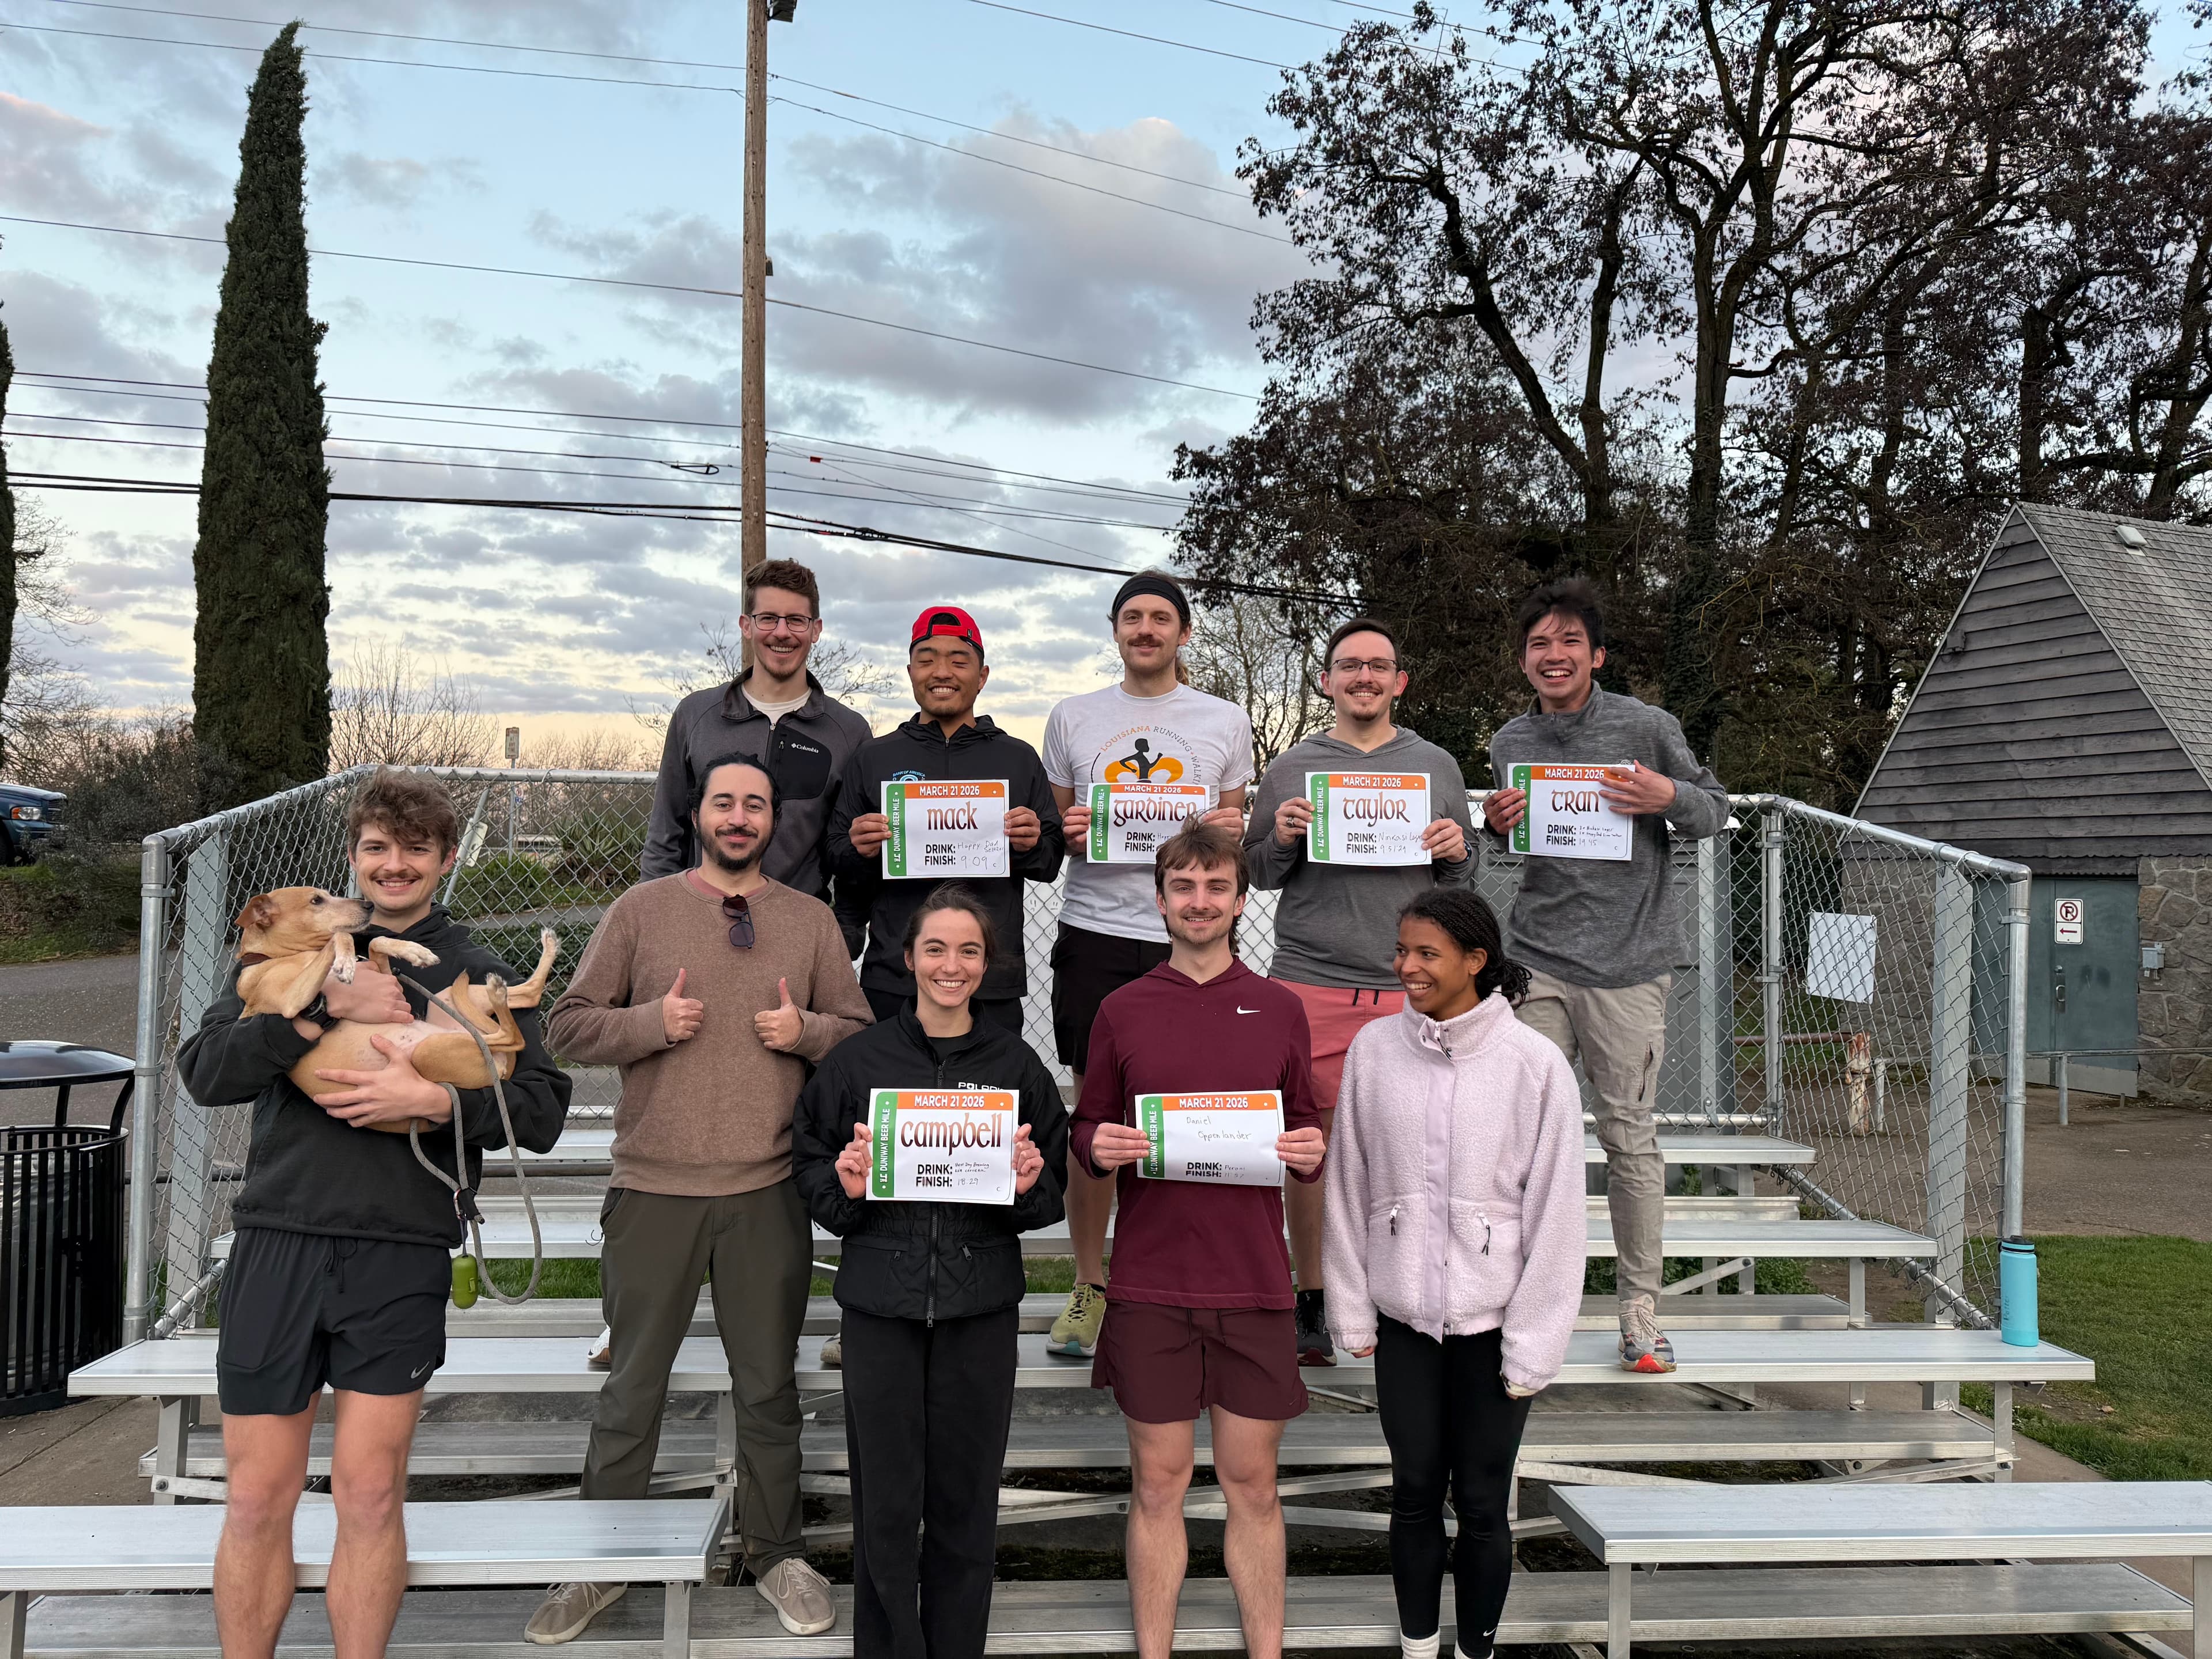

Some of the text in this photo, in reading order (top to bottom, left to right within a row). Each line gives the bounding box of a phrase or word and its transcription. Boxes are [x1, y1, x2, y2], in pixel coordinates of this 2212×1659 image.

[796, 744, 819, 753] Columbia
[1101, 726, 1151, 752] LOUISIANA
[1153, 726, 1192, 752] RUNNING
[1191, 756, 1202, 785] WALKI
[1545, 768, 1604, 779] MARCH 21 2026
[1343, 777, 1402, 787] MARCH 21 2026
[920, 785, 980, 796] MARCH 21 2026
[927, 801, 979, 830] mack
[1547, 824, 1577, 835] DRINK:
[893, 827, 901, 851] DUNIWAY
[1126, 832, 1156, 842] DRINK:
[1347, 833, 1377, 843] DRINK:
[1546, 835, 1576, 846] FINISH:
[926, 844, 956, 854] DRINK:
[957, 842, 980, 851] Happy
[1125, 842, 1155, 852] FINISH:
[1346, 844, 1377, 853] FINISH:
[925, 855, 956, 866] FINISH:
[915, 1095, 984, 1107] MARCH 21 2026
[1179, 1097, 1248, 1108] MARCH 21 2026
[881, 1108, 890, 1123] MILE
[1149, 1111, 1157, 1123] MILE
[1186, 1116, 1212, 1125] Daniel
[880, 1124, 889, 1141] BEER
[900, 1112, 1002, 1156] campbell
[1150, 1124, 1158, 1141] BEER
[880, 1142, 888, 1171] DUNIWAY
[918, 1164, 953, 1175] DRINK:
[1187, 1162, 1222, 1171] DRINK:
[916, 1176, 953, 1187] FINISH:
